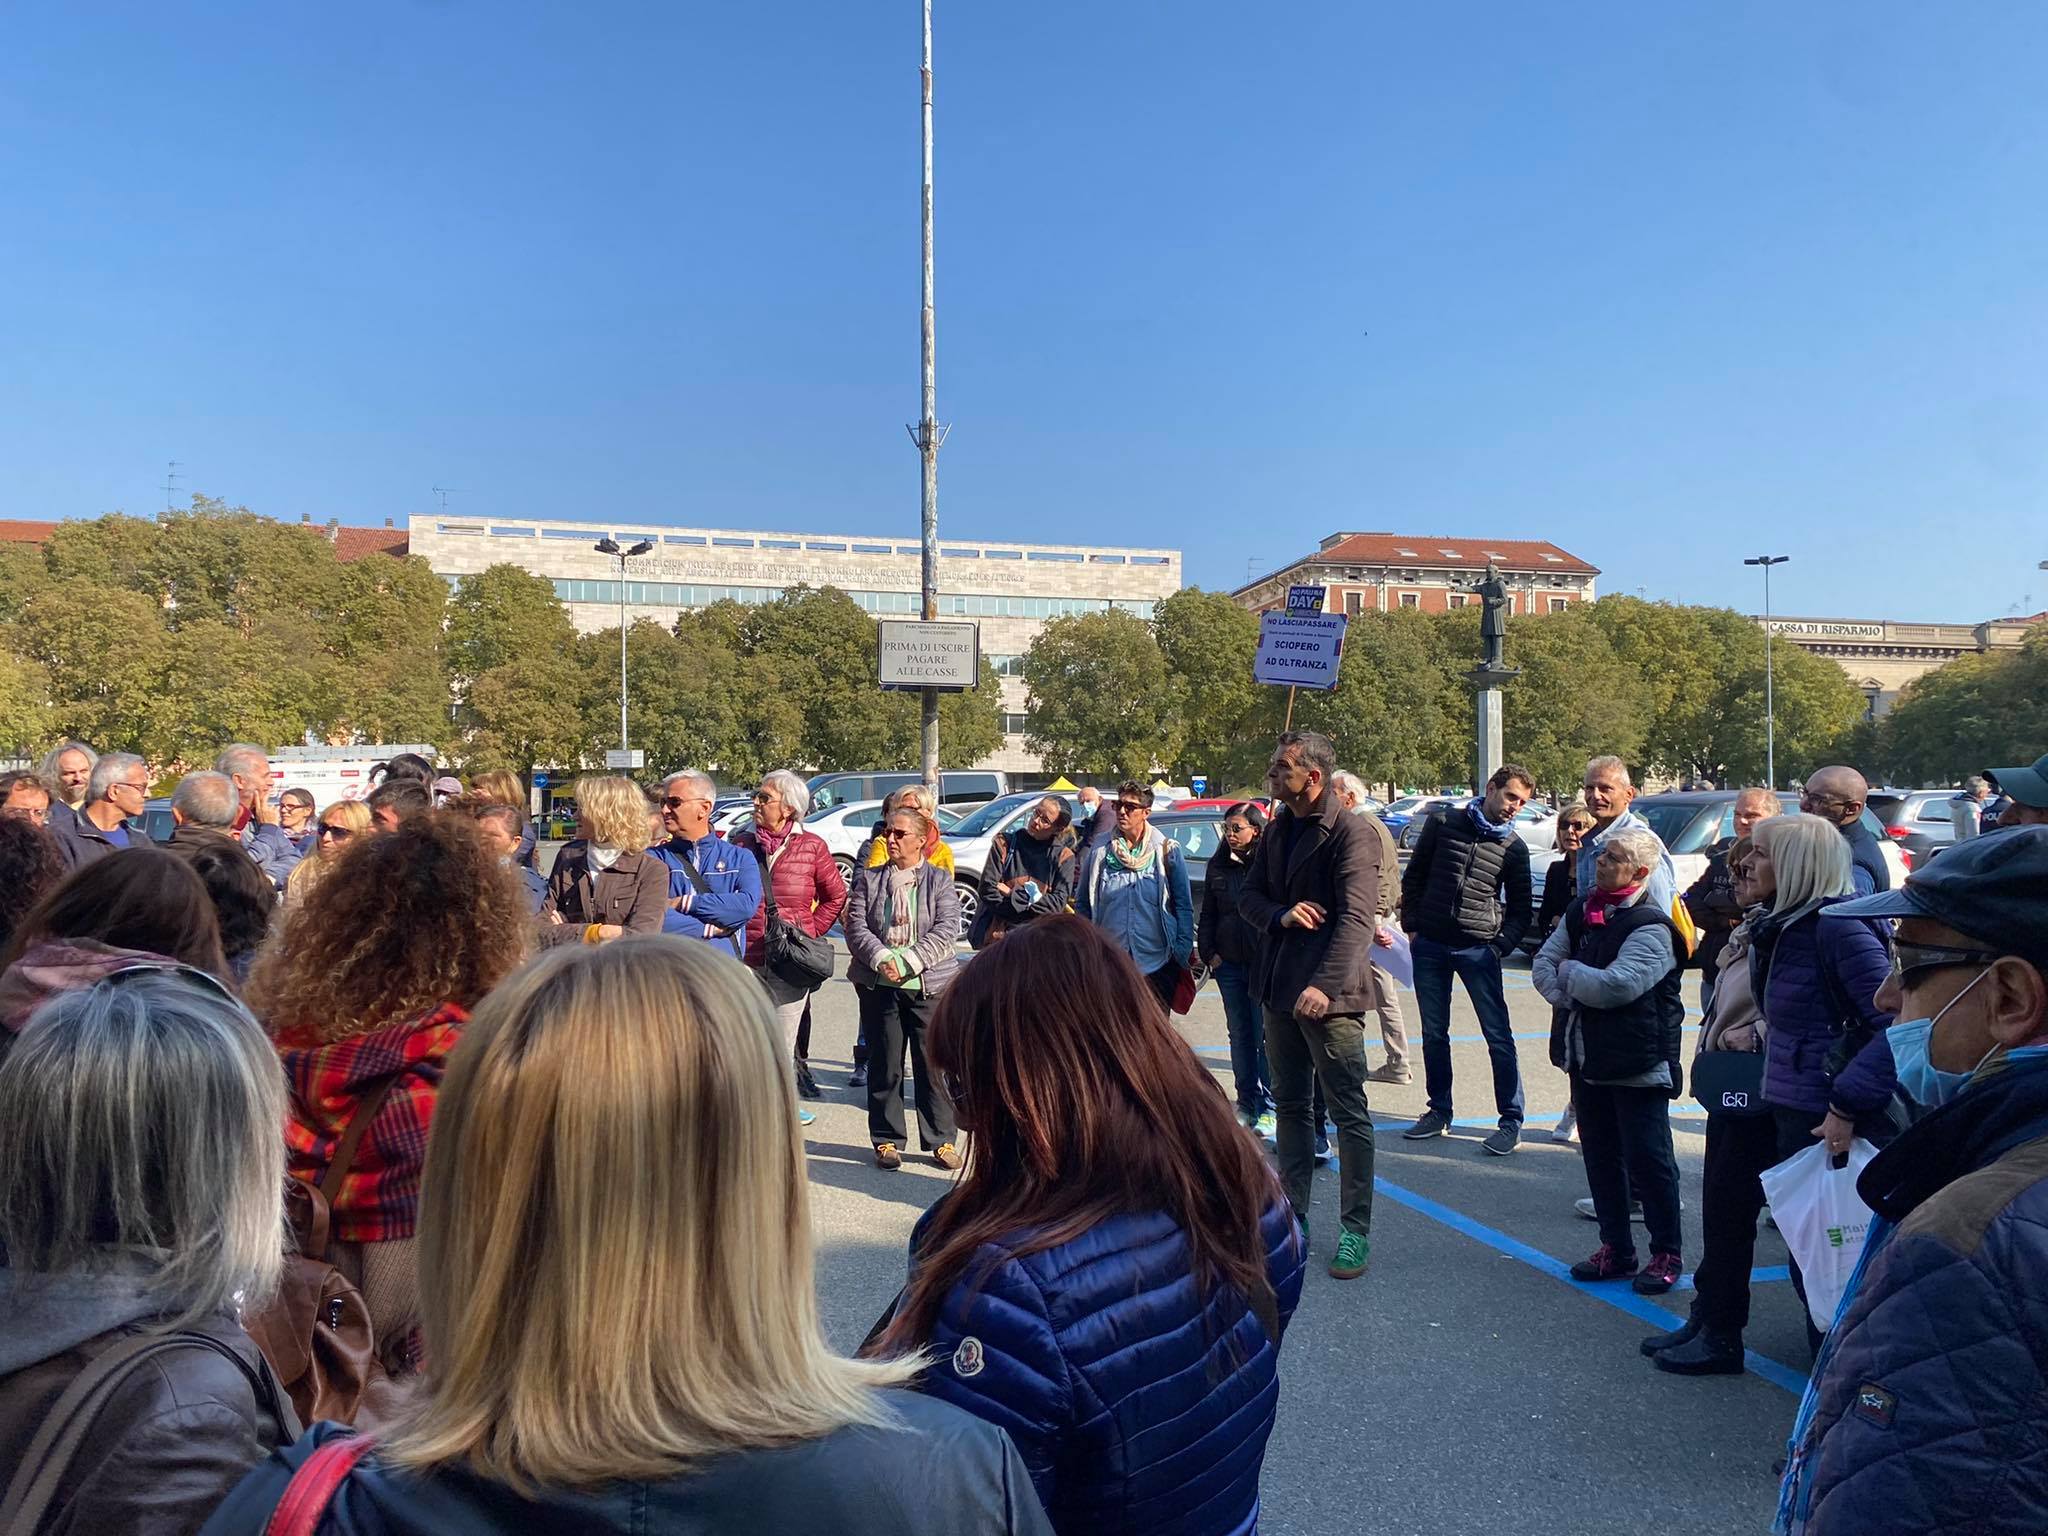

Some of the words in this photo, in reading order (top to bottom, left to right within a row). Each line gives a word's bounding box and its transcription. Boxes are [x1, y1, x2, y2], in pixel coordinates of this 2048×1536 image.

[1288, 596, 1314, 608] DAY
[1278, 618, 1338, 629] LASCIAPASSARE
[1769, 622, 1804, 633] CASSA
[1806, 623, 1819, 634] DI
[1821, 624, 1881, 637] RISPARMIO
[884, 642, 918, 652] PRIMA
[920, 643, 931, 652] DI
[933, 643, 971, 653] USCIRE
[1274, 640, 1320, 652] SCIOPERO
[906, 655, 948, 664] PAGARE
[1265, 657, 1277, 666] AD
[1278, 657, 1328, 670] OLTRANZA
[896, 667, 923, 676] ALLE
[925, 667, 958, 677] CASSE
